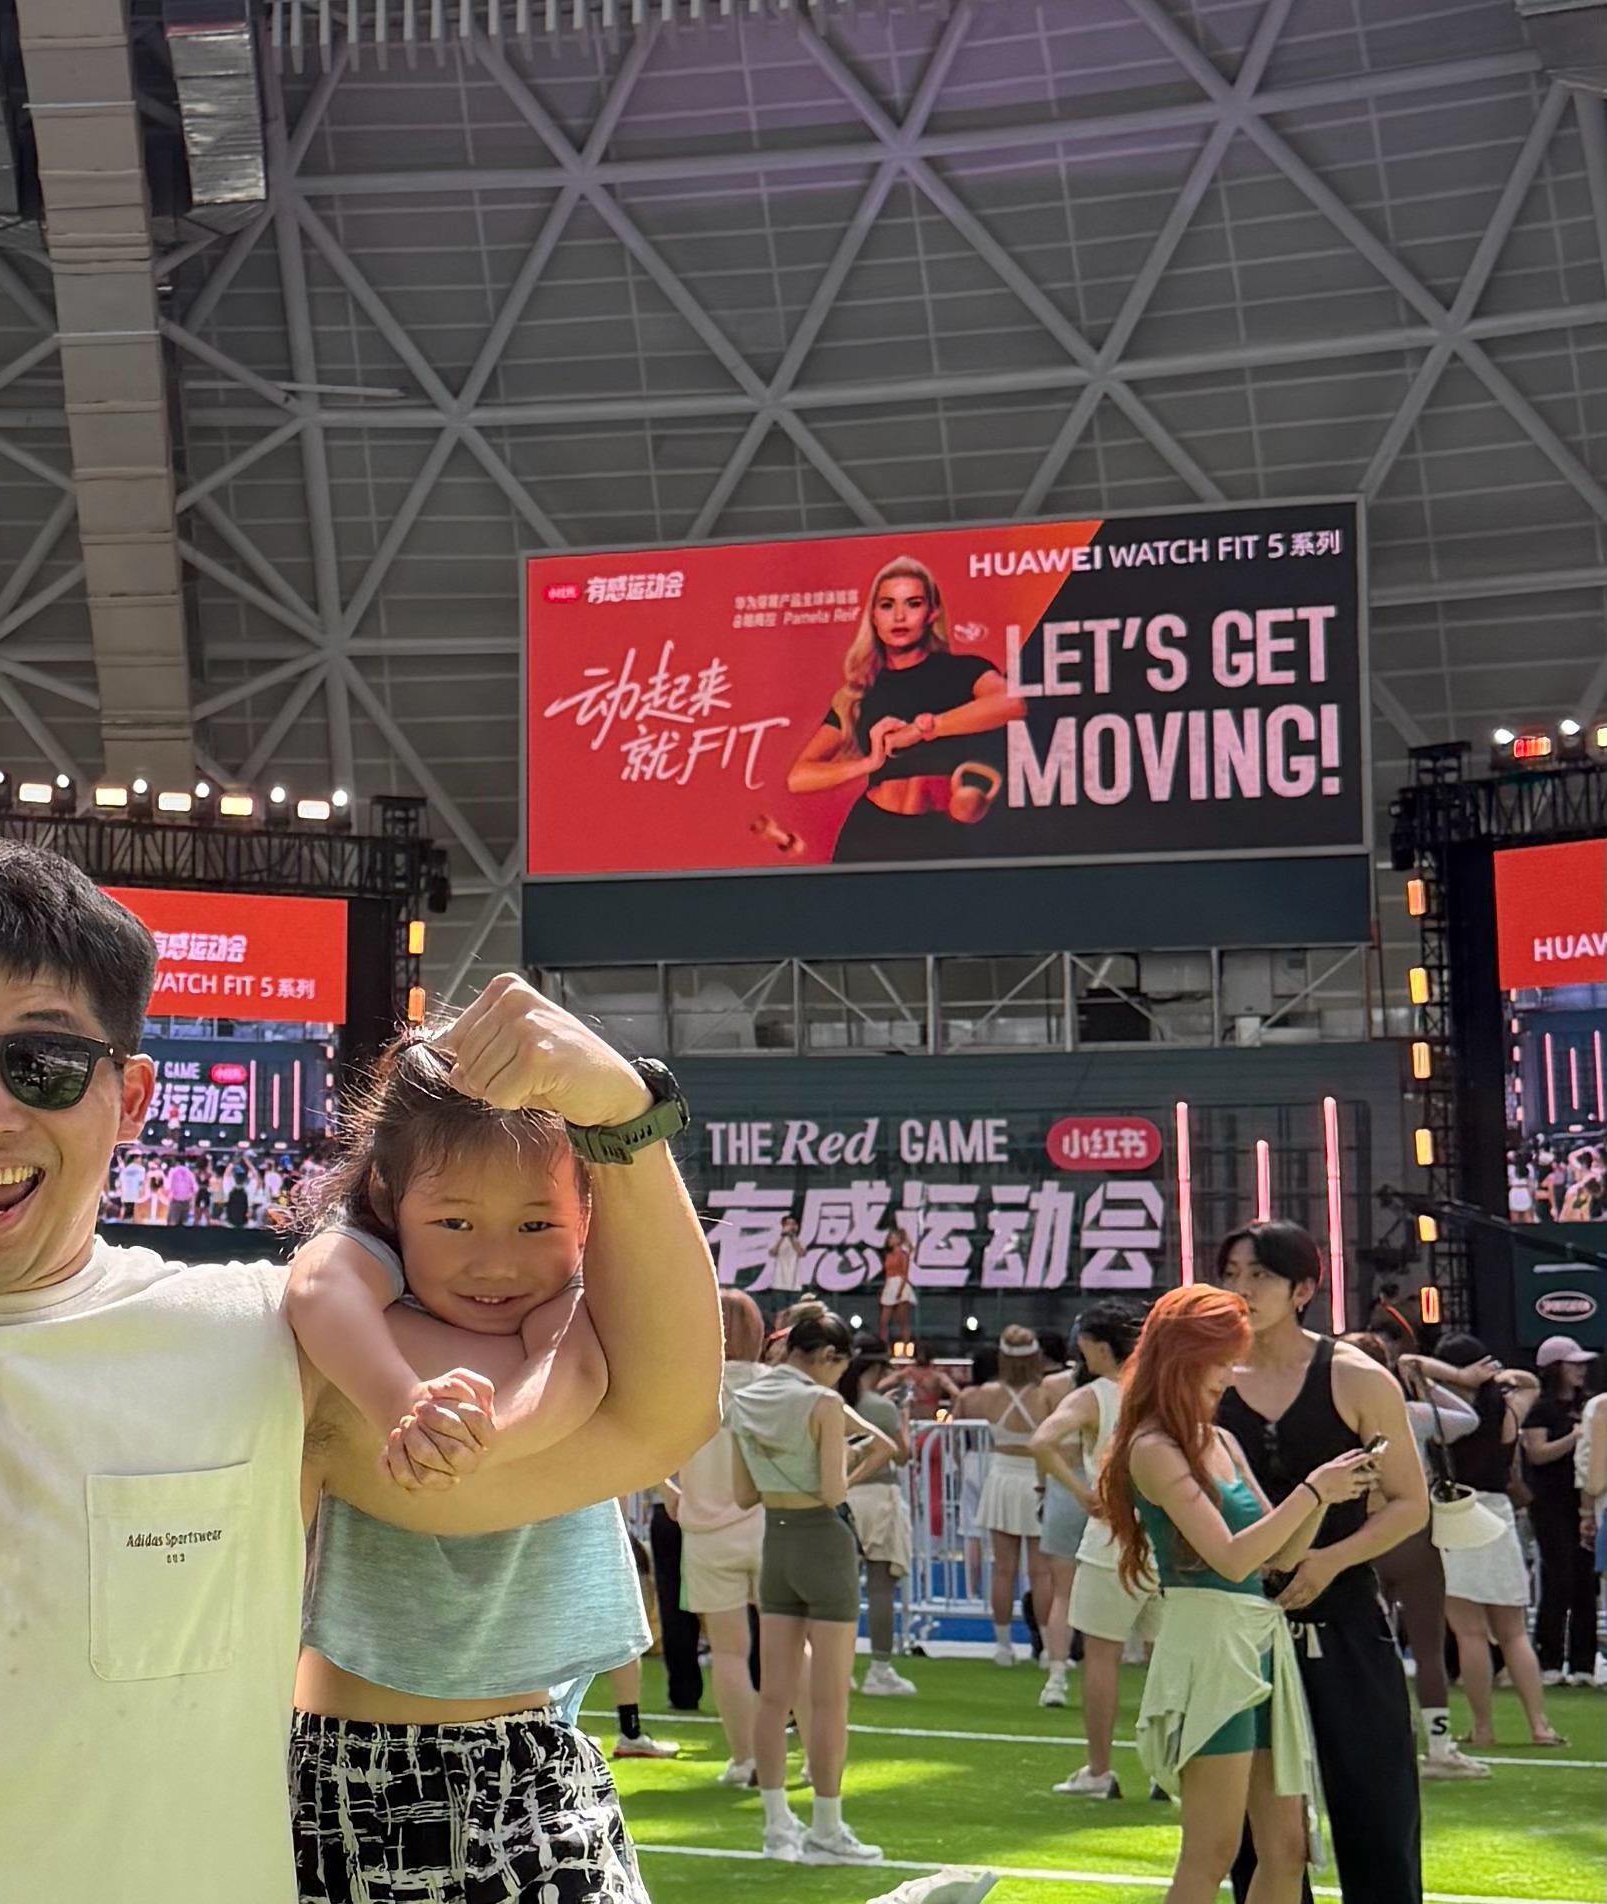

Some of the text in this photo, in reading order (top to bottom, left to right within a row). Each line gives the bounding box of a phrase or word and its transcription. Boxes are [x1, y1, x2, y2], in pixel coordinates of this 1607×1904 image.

[969, 529, 1343, 578] HUAWEI WATCH FIT 5 系列
[585, 571, 684, 604] 有感运动会
[1006, 605, 1336, 696] LET'S GET
[544, 640, 732, 751] 动起来
[1006, 703, 1341, 809] MOVING!
[224, 976, 255, 997] FIT
[260, 977, 273, 997] 5
[277, 978, 315, 1000] 系列
[164, 1061, 200, 1080] GAME
[705, 1118, 1009, 1166] THE Red GAME
[1061, 1128, 1149, 1161] 小红书
[706, 1180, 1165, 1293] 有感运动会
[126, 1533, 164, 1547] Adidas
[1431, 1715, 1448, 1735] S
